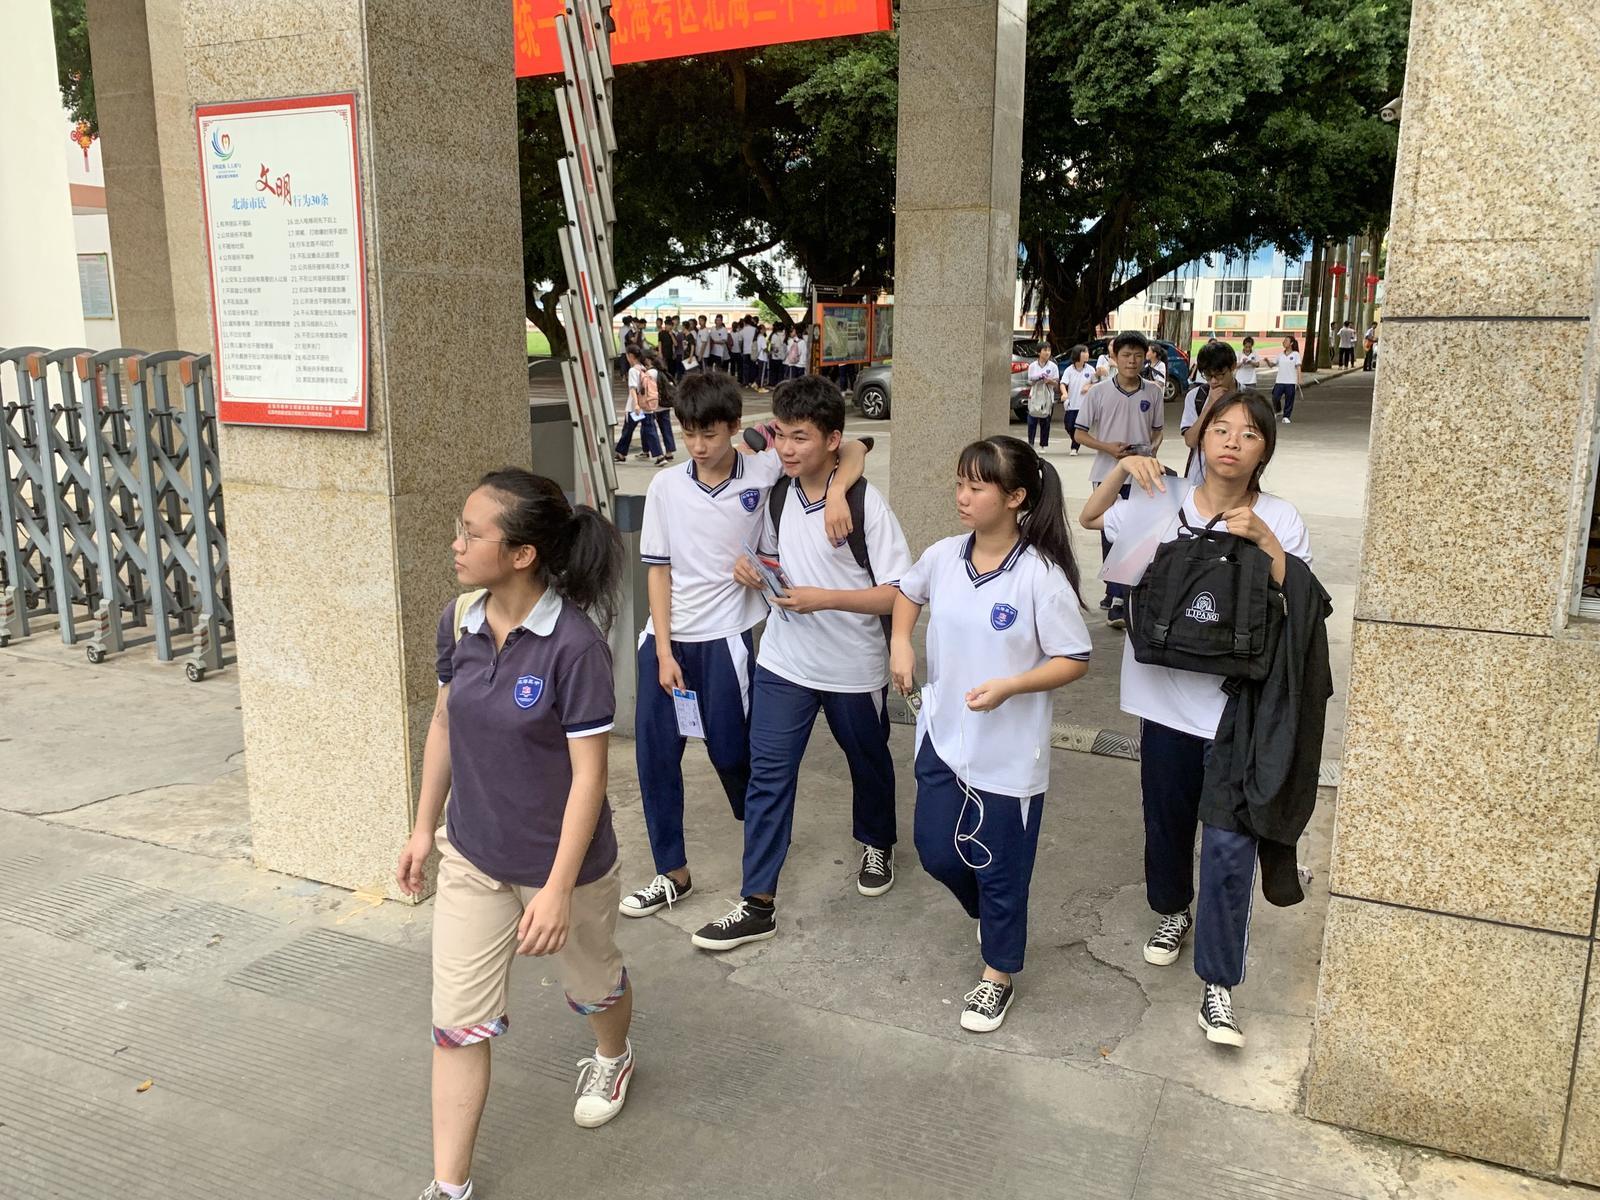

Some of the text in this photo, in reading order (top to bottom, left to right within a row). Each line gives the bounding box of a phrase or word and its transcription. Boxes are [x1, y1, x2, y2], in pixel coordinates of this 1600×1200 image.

[232, 163, 329, 210] 北海市民 文明 行为30条
